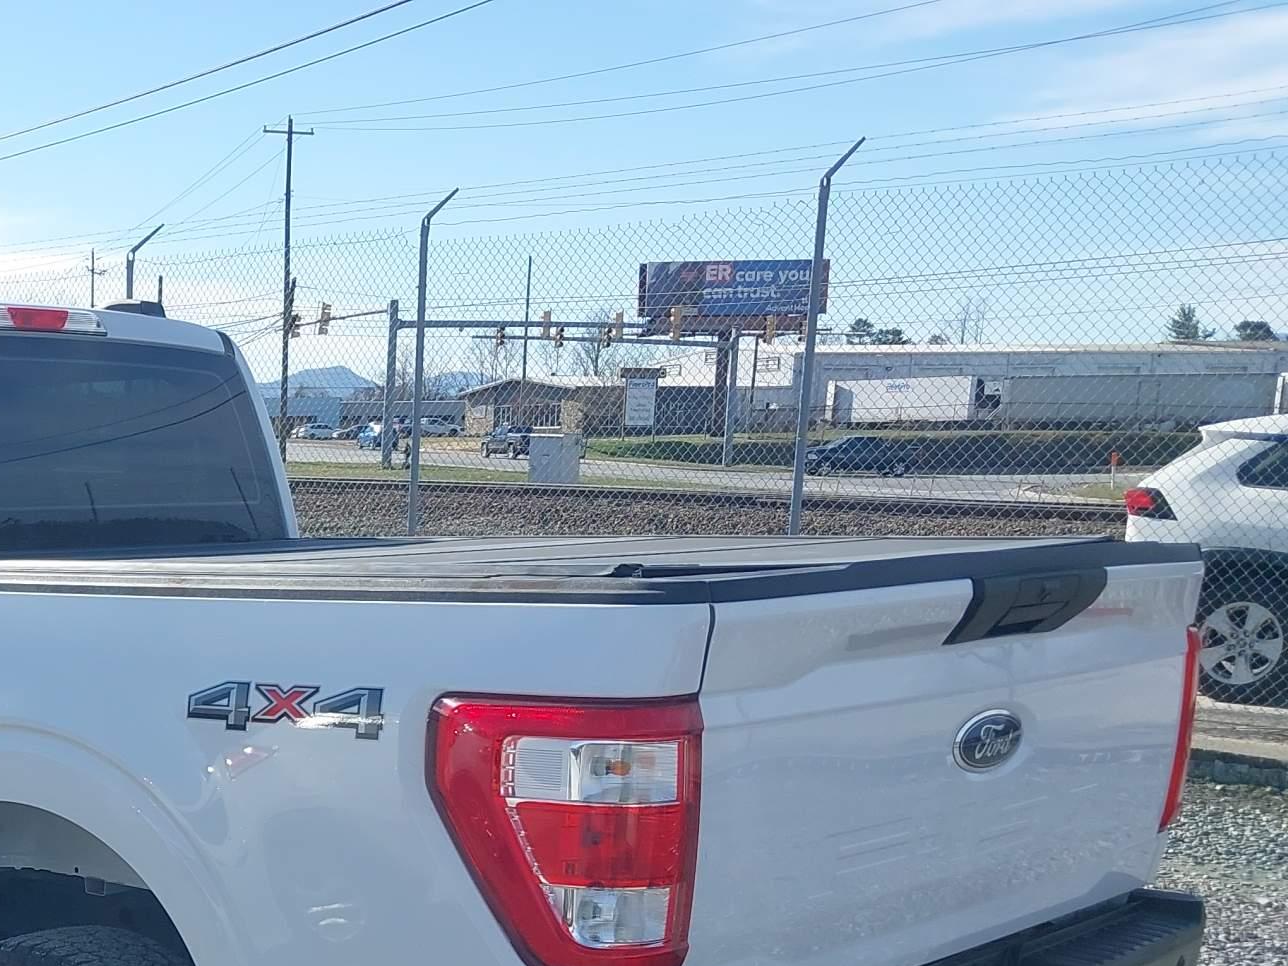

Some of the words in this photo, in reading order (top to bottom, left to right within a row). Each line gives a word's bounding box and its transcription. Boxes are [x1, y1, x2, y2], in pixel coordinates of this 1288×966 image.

[706, 265, 731, 281] ER
[735, 270, 773, 281] care
[779, 270, 809, 284] you
[702, 288, 733, 299] can
[736, 286, 780, 299] trust.
[975, 723, 1014, 760] Ford
